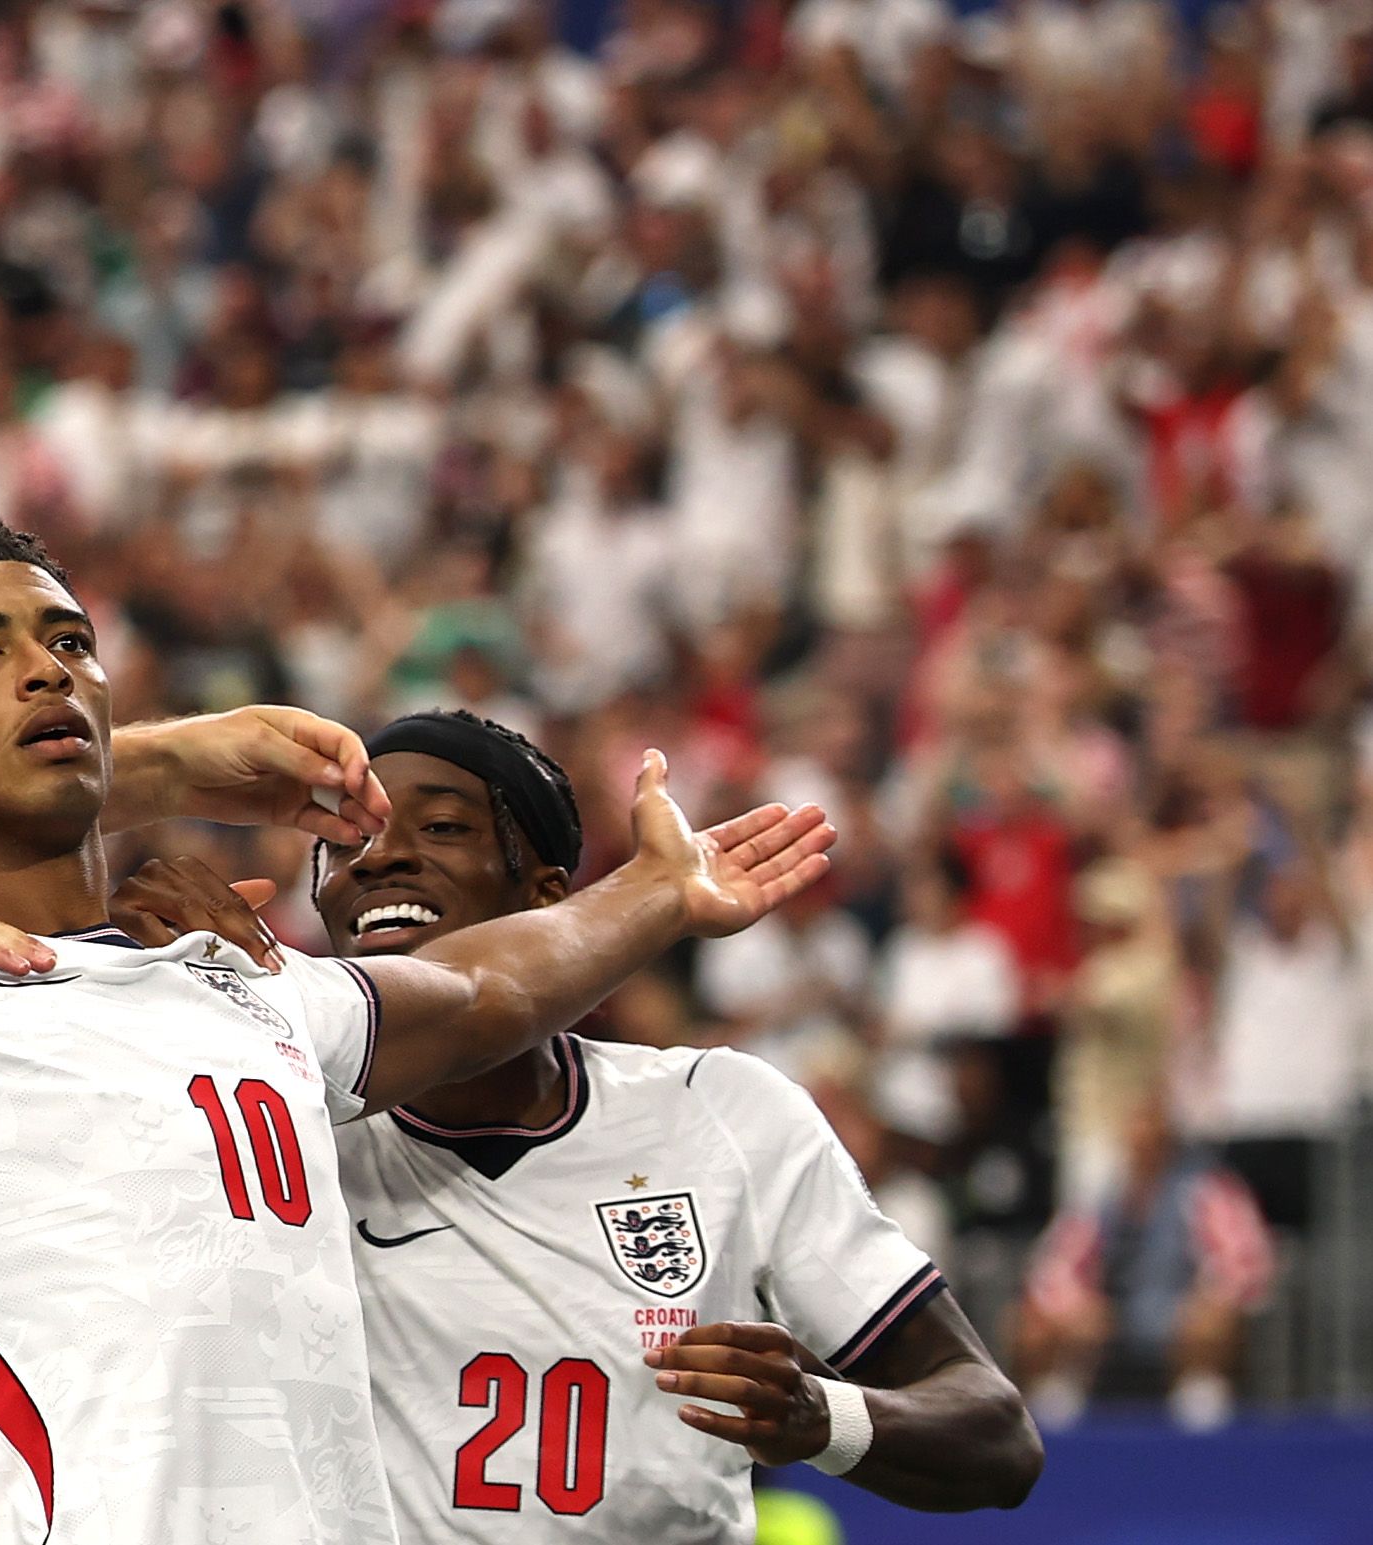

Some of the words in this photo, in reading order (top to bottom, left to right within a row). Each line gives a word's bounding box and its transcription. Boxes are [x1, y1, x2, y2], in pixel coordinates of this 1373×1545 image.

[187, 1074, 312, 1228] 10
[635, 1308, 697, 1328] CROATIA
[453, 1352, 610, 1517] 20
